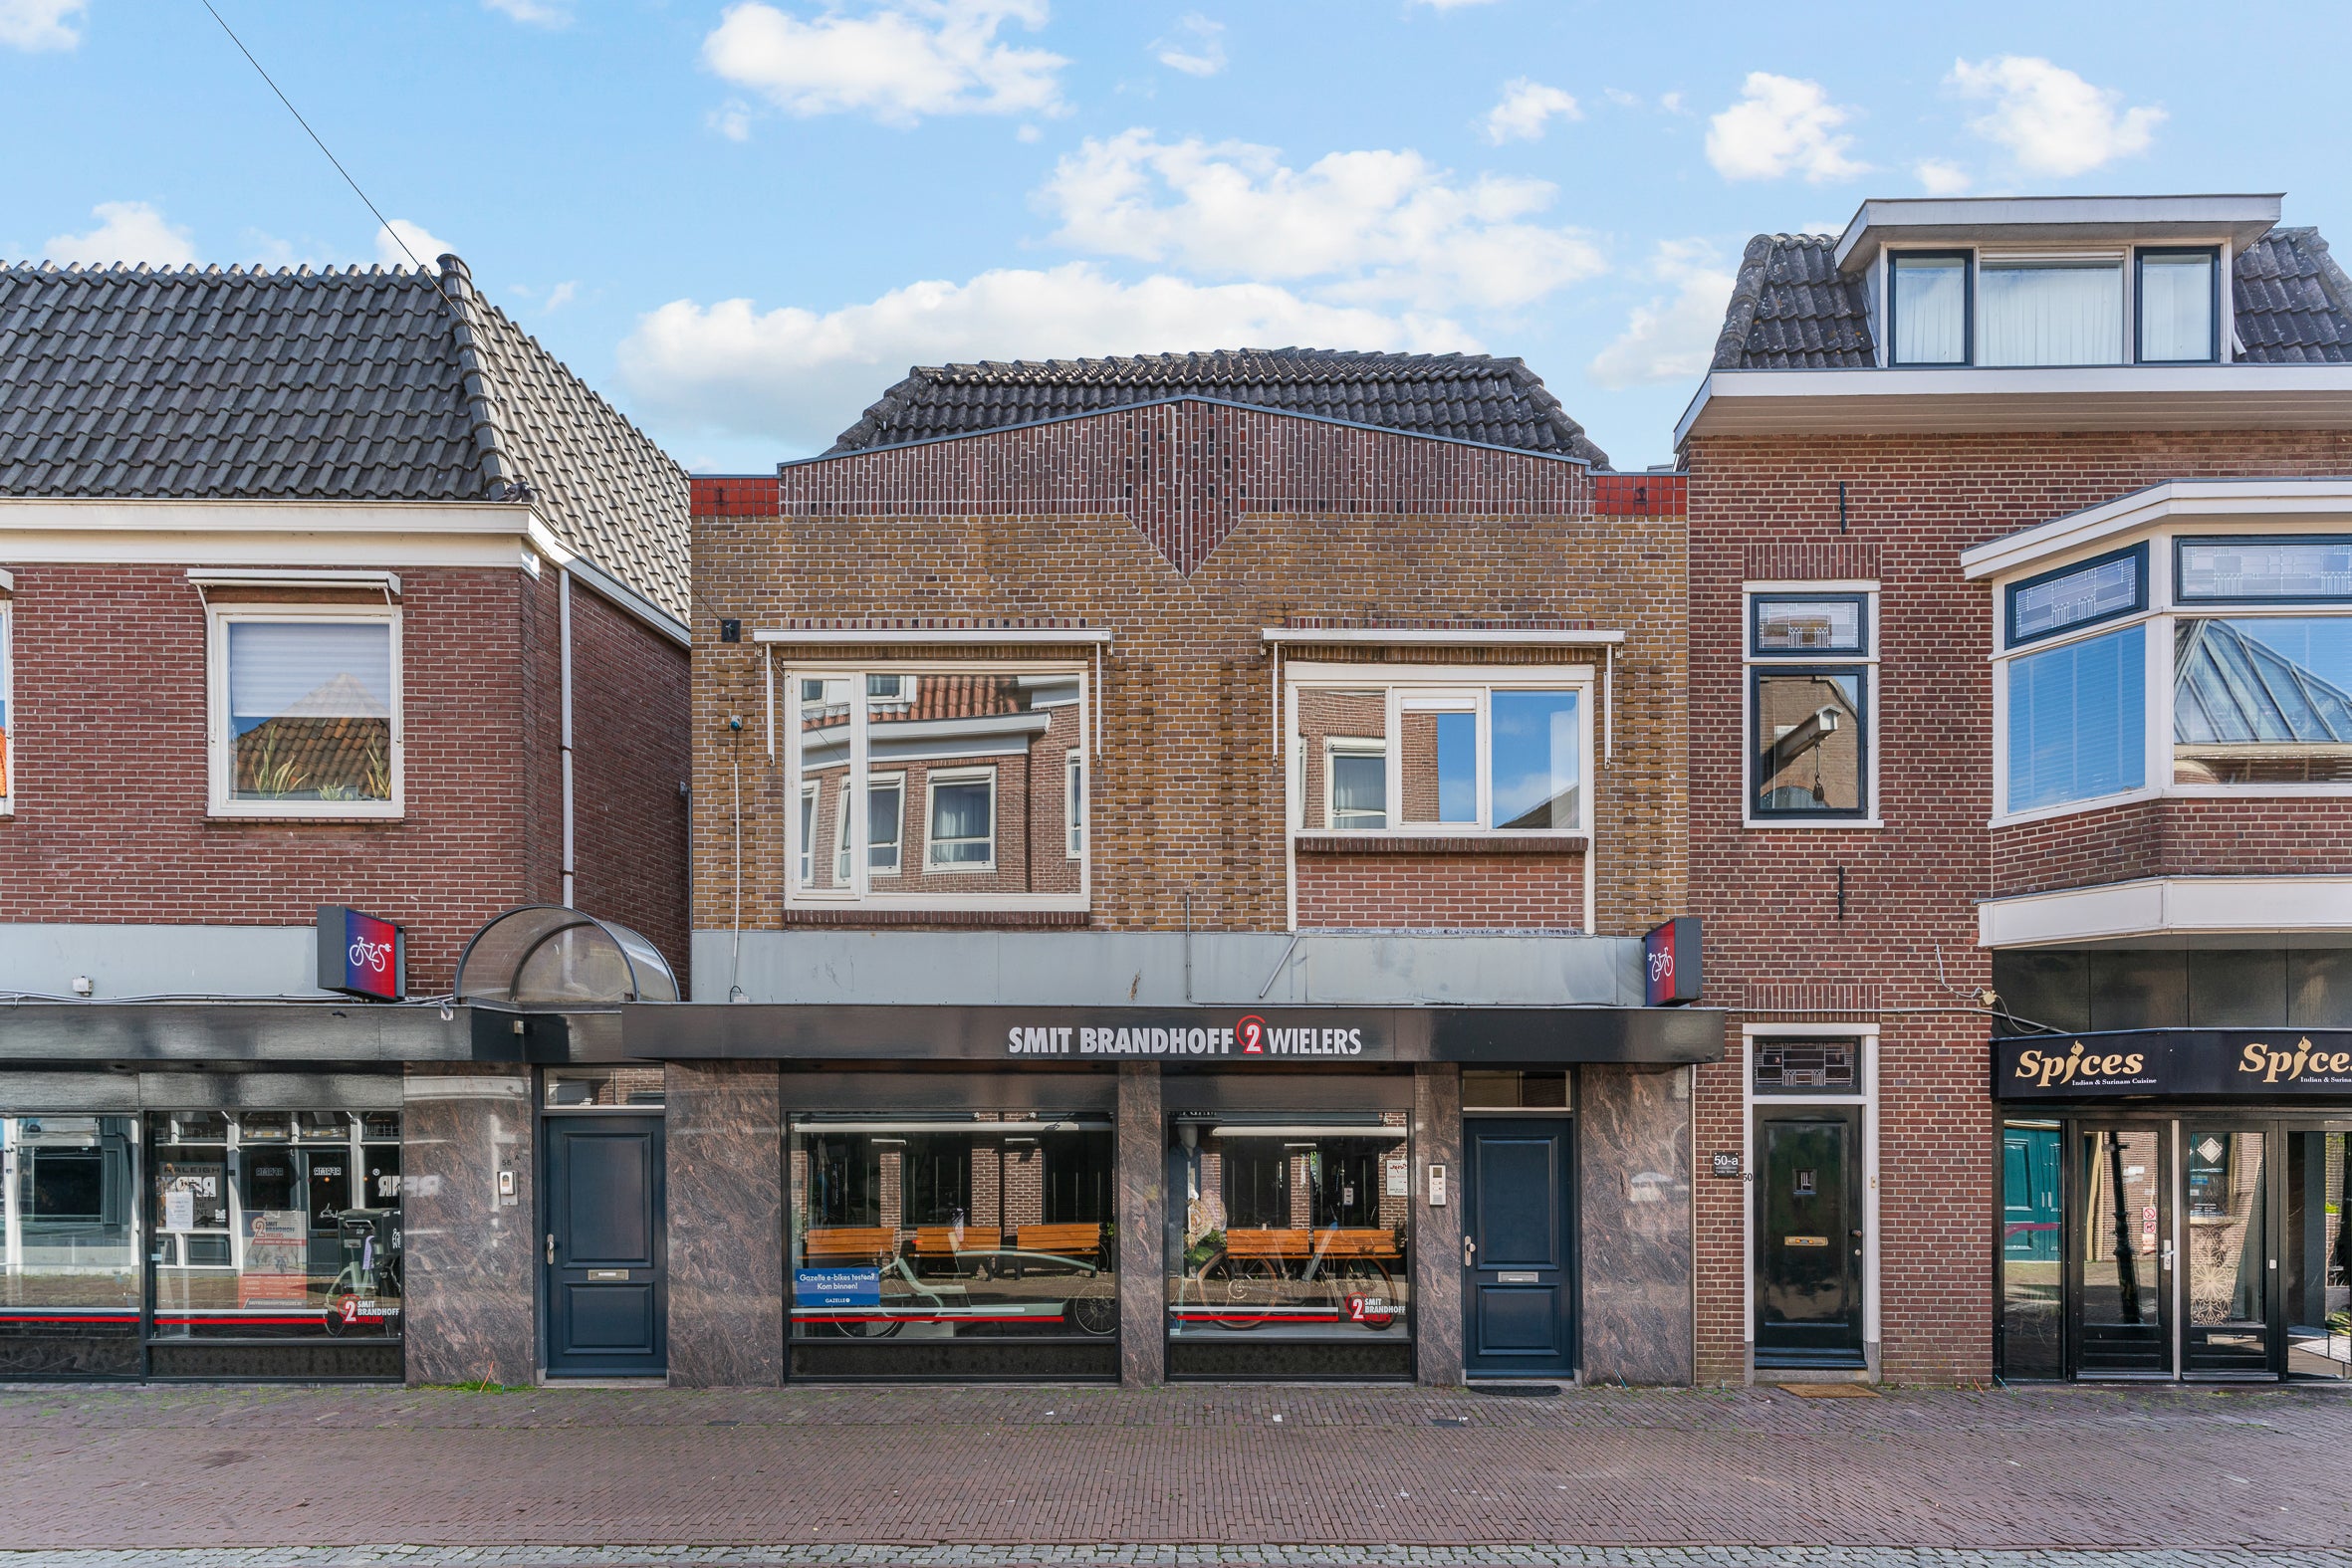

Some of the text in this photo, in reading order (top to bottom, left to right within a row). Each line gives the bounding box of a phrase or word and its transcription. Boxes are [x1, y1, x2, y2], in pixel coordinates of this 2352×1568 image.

[1009, 1021, 1361, 1054] SMIT BRANDHOFF 2 WIELERS
[2015, 1040, 2144, 1087] Spices
[2238, 1036, 2352, 1083] Spice
[1714, 1155, 1739, 1166] 50-a
[1743, 1173, 1753, 1182] 50
